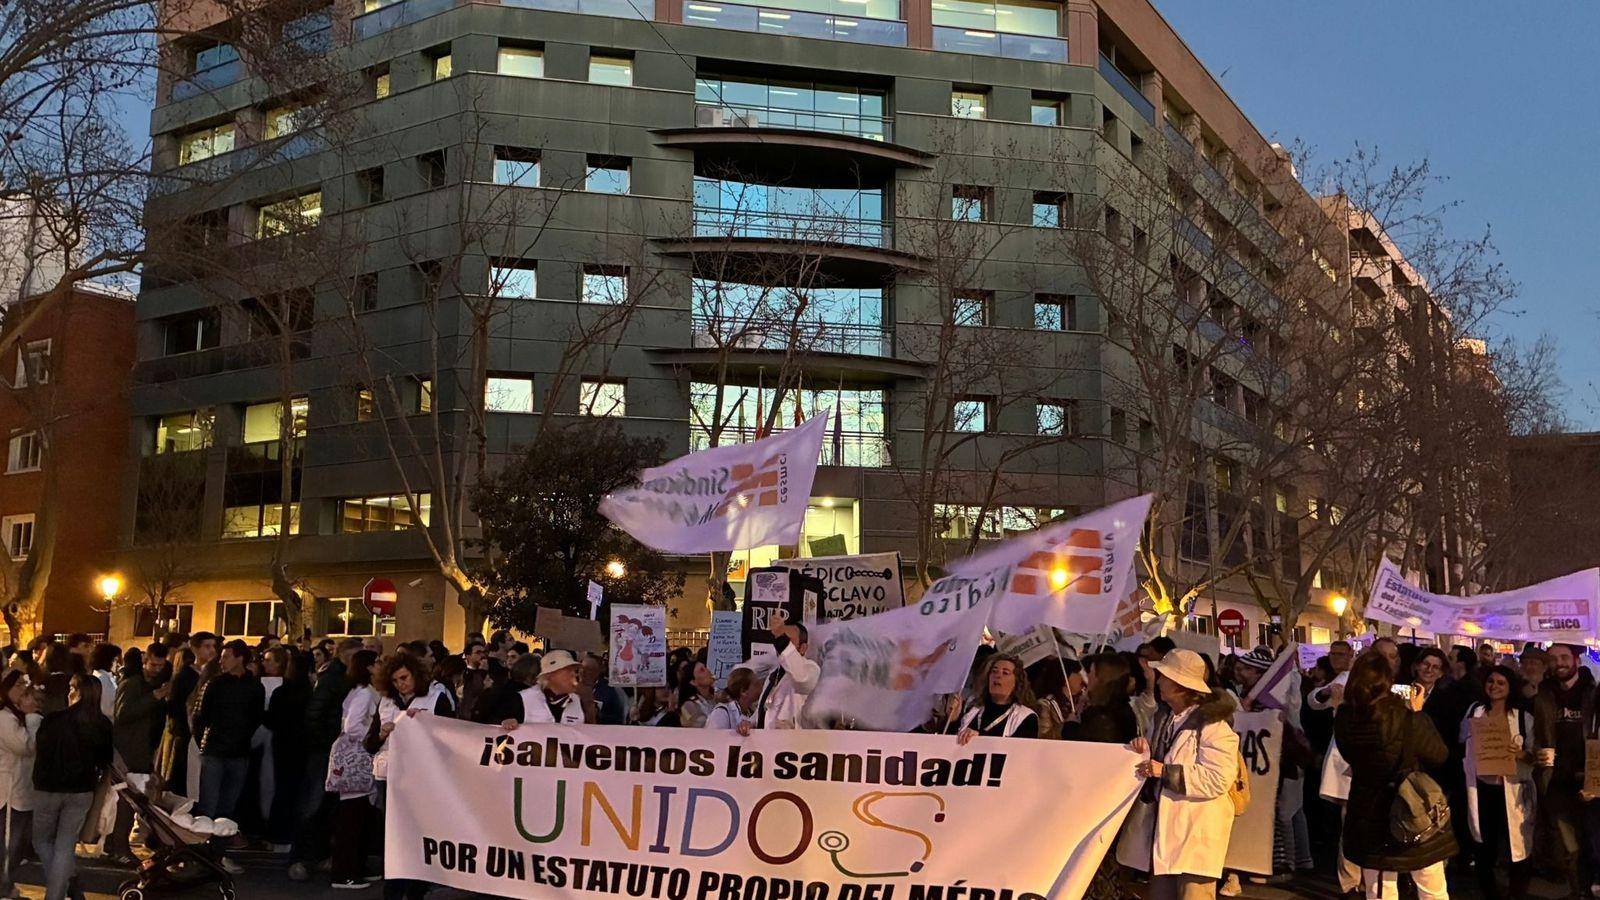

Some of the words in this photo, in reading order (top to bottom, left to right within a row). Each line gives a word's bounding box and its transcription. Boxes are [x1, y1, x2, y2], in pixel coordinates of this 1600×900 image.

[802, 563, 854, 584] ÉDICO
[841, 603, 867, 621] 24
[726, 745, 763, 779] la
[773, 749, 1007, 787] sanidad!
[513, 777, 946, 877] UNIDOS
[423, 837, 477, 874] POR
[486, 846, 526, 881] UN
[531, 854, 691, 900] ESTATUTO
[696, 871, 830, 900] PROPIO
